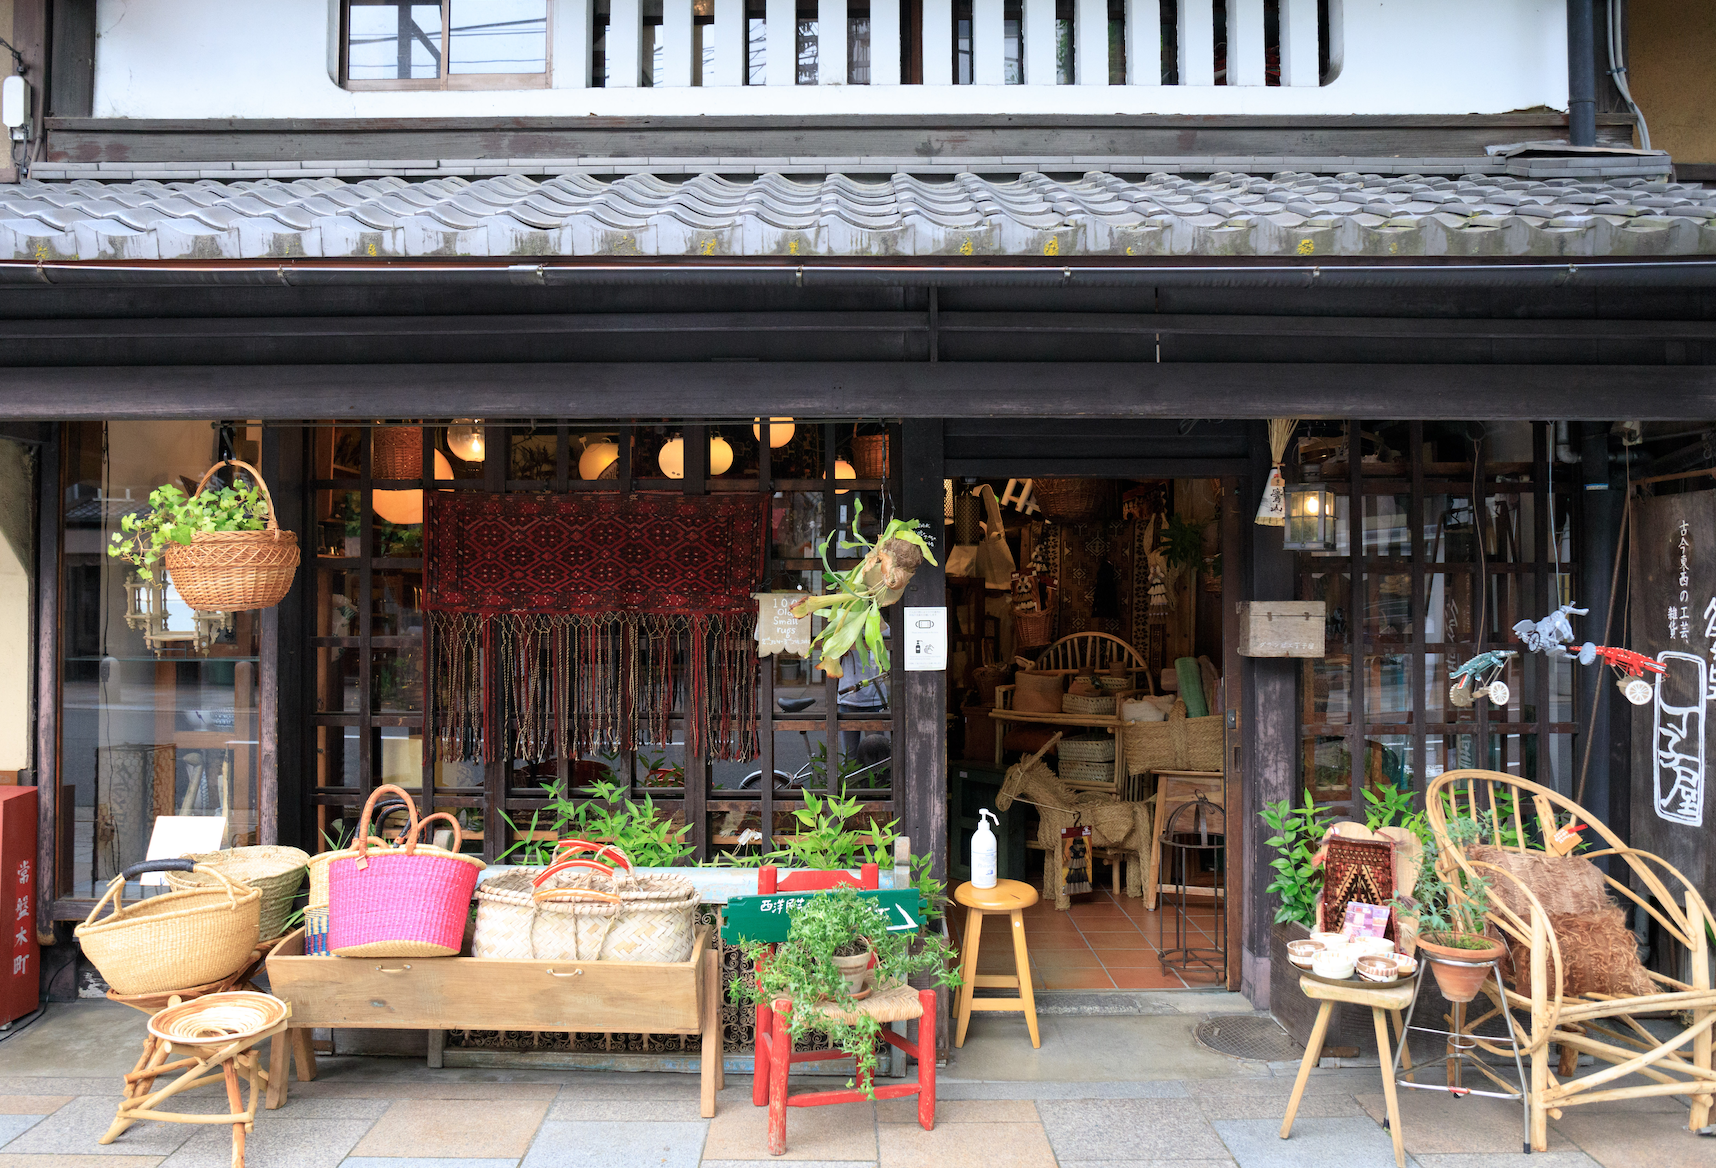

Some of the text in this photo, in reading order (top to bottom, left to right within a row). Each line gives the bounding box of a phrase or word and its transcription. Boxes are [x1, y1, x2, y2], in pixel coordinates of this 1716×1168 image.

[773, 616, 799, 626] Small
[776, 626, 796, 639] rugs
[1667, 605, 1678, 640] 雑貨
[13, 860, 31, 976] 常盤木町
